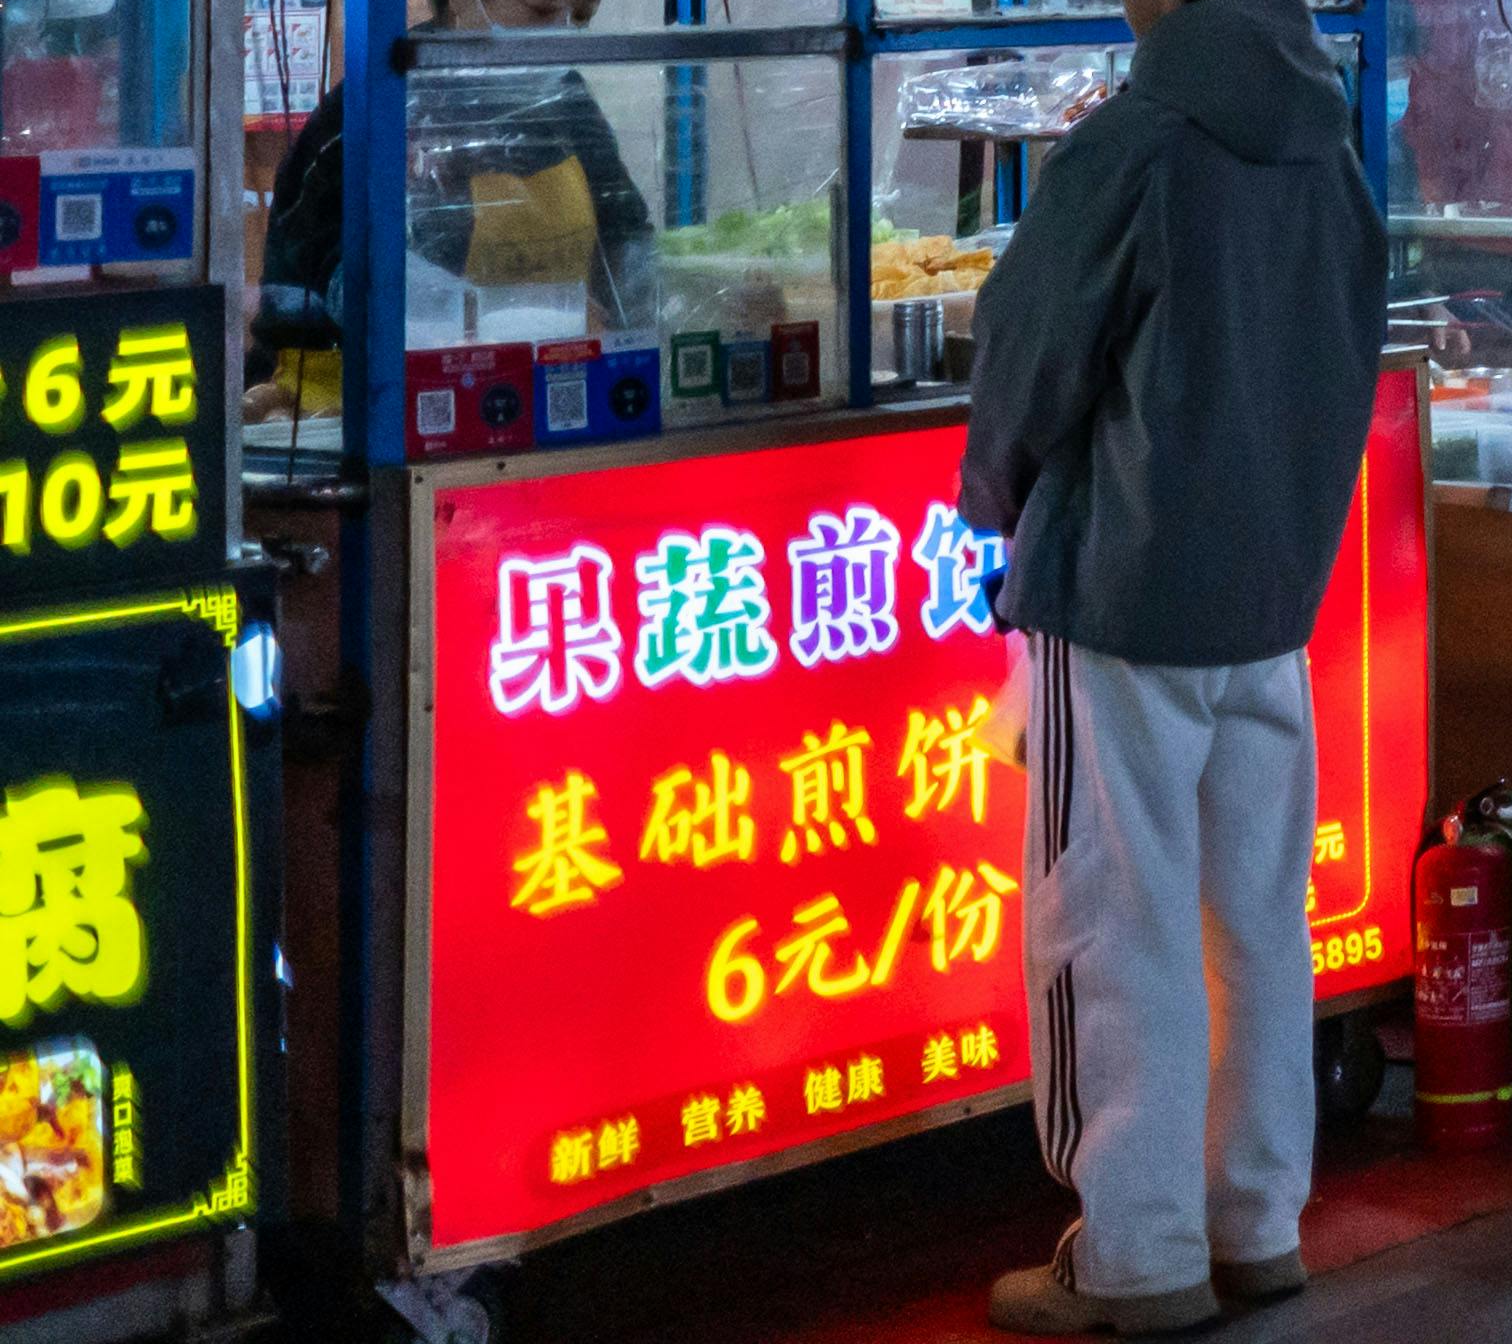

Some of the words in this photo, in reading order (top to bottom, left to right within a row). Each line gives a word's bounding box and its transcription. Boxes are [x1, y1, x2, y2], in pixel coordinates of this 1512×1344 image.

[508, 695, 993, 918] 基础煎饼
[704, 862, 1023, 1025] 6元/份
[548, 1115, 640, 1185] 新鲜
[680, 1084, 766, 1148] 营养
[802, 1055, 885, 1113] 健康
[919, 1023, 999, 1087] 美味
